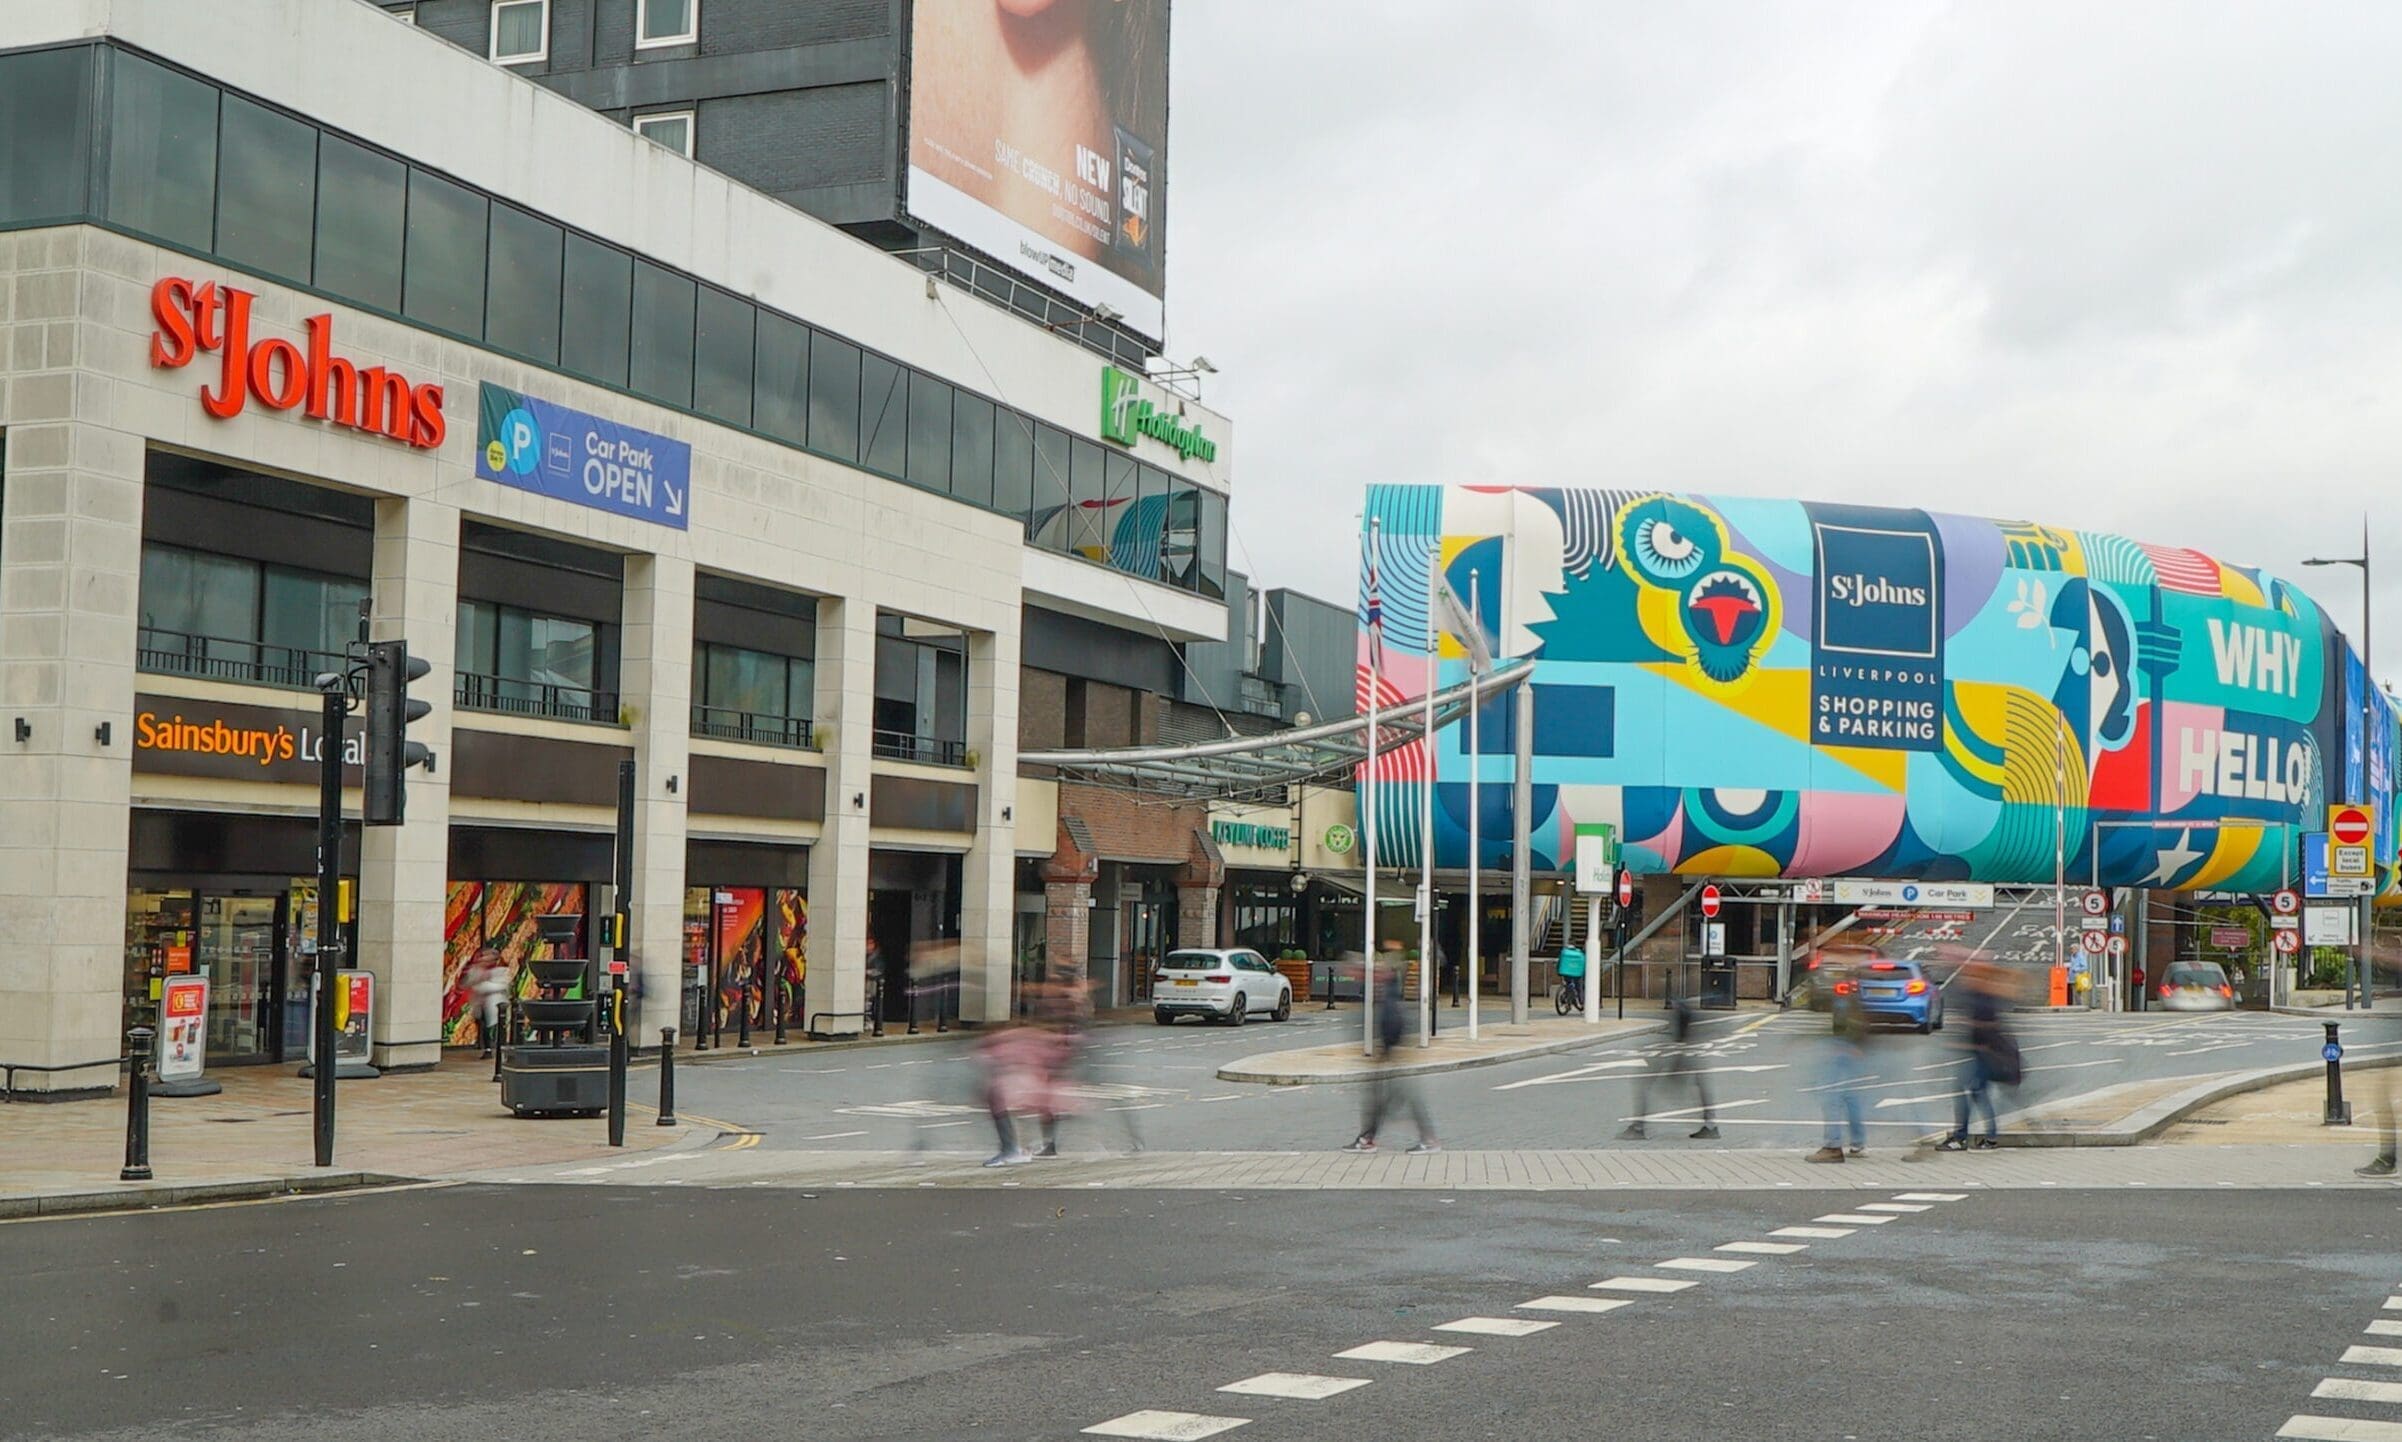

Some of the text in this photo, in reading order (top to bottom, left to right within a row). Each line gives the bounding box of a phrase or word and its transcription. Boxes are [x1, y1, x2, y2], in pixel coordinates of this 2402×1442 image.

[995, 138, 1020, 174] SAME
[1065, 179, 1078, 206] NO
[1079, 187, 1112, 225] SOUND.
[1076, 143, 1110, 192] NEW
[1123, 175, 1149, 221] SILENT
[585, 431, 654, 471] Car Park
[583, 458, 654, 508] OPEN
[1819, 665, 1937, 685] LIVERPOOL
[2207, 618, 2301, 699] WHY
[1819, 695, 1935, 720] SHOPPING
[136, 712, 366, 766] Sainsbury's Lal
[1818, 716, 1935, 741] & PARKING
[2179, 727, 2312, 807] HELLO!
[2338, 849, 2364, 857] Except
[1928, 889, 1968, 898] Car Park
[2090, 898, 2100, 910] 5
[2281, 896, 2290, 908] 5
